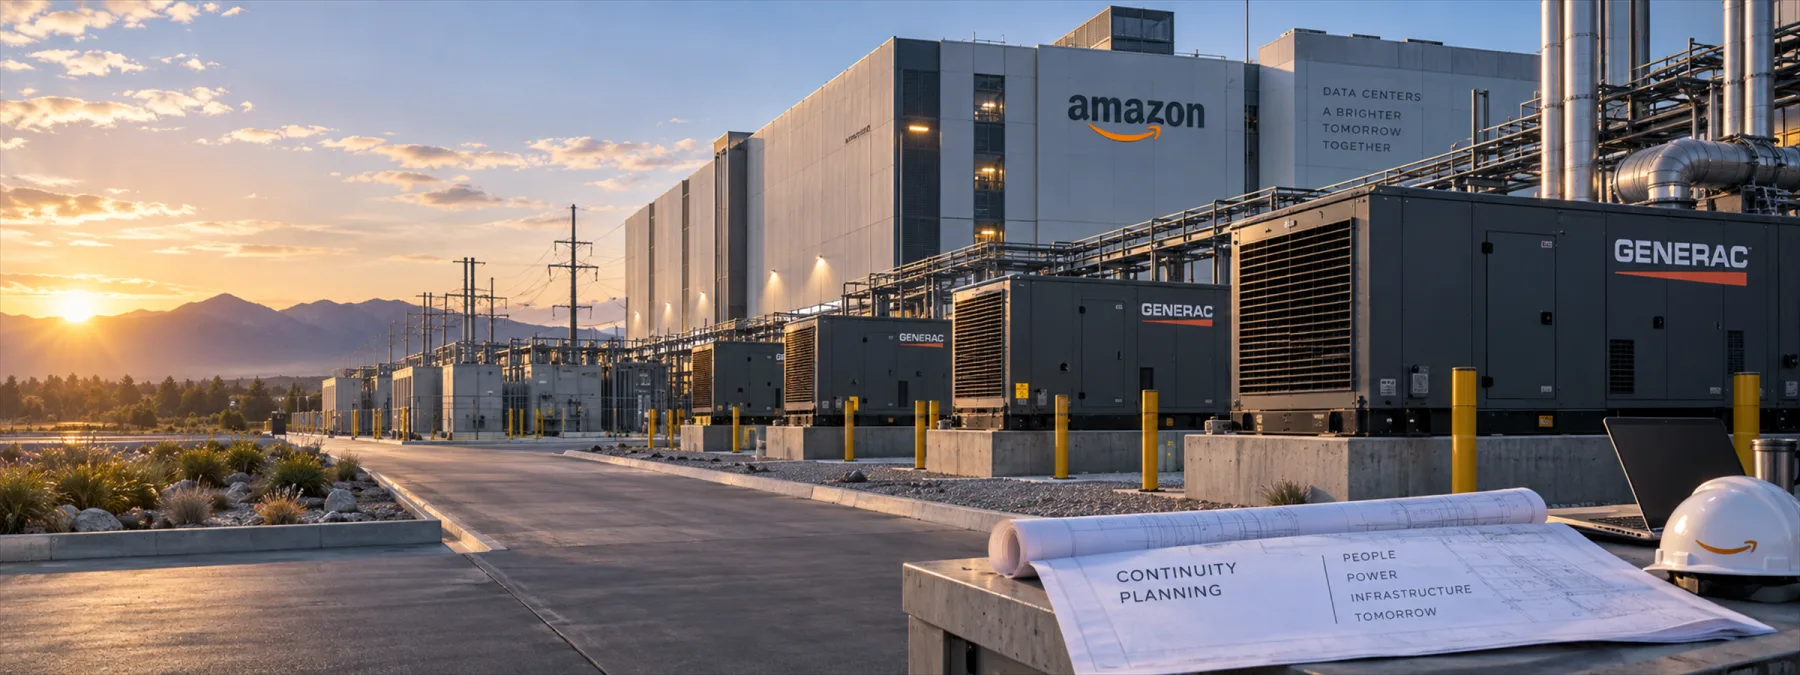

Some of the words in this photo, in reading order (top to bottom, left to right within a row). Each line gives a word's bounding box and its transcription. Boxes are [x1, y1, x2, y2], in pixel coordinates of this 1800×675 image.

[1322, 87, 1357, 99] DATA
[1361, 89, 1422, 102] CENTERS
[1067, 94, 1205, 129] amazon
[1322, 107, 1332, 117] A
[1336, 107, 1402, 120] BRIGHTER
[1322, 123, 1402, 136] TOMORROW
[1322, 140, 1391, 153] TOGETHER
[1614, 238, 1749, 269] GENERAC
[1141, 302, 1214, 318] GENERAC
[899, 332, 944, 343] GENERAC
[1342, 549, 1396, 563] PEOPLE
[1116, 561, 1237, 583] CONTINUITY
[1346, 569, 1398, 582] POWER
[1119, 583, 1222, 604] PLANNING
[1350, 584, 1472, 603] INFRASTRUCTURE
[1354, 607, 1437, 622] TOMORROW
